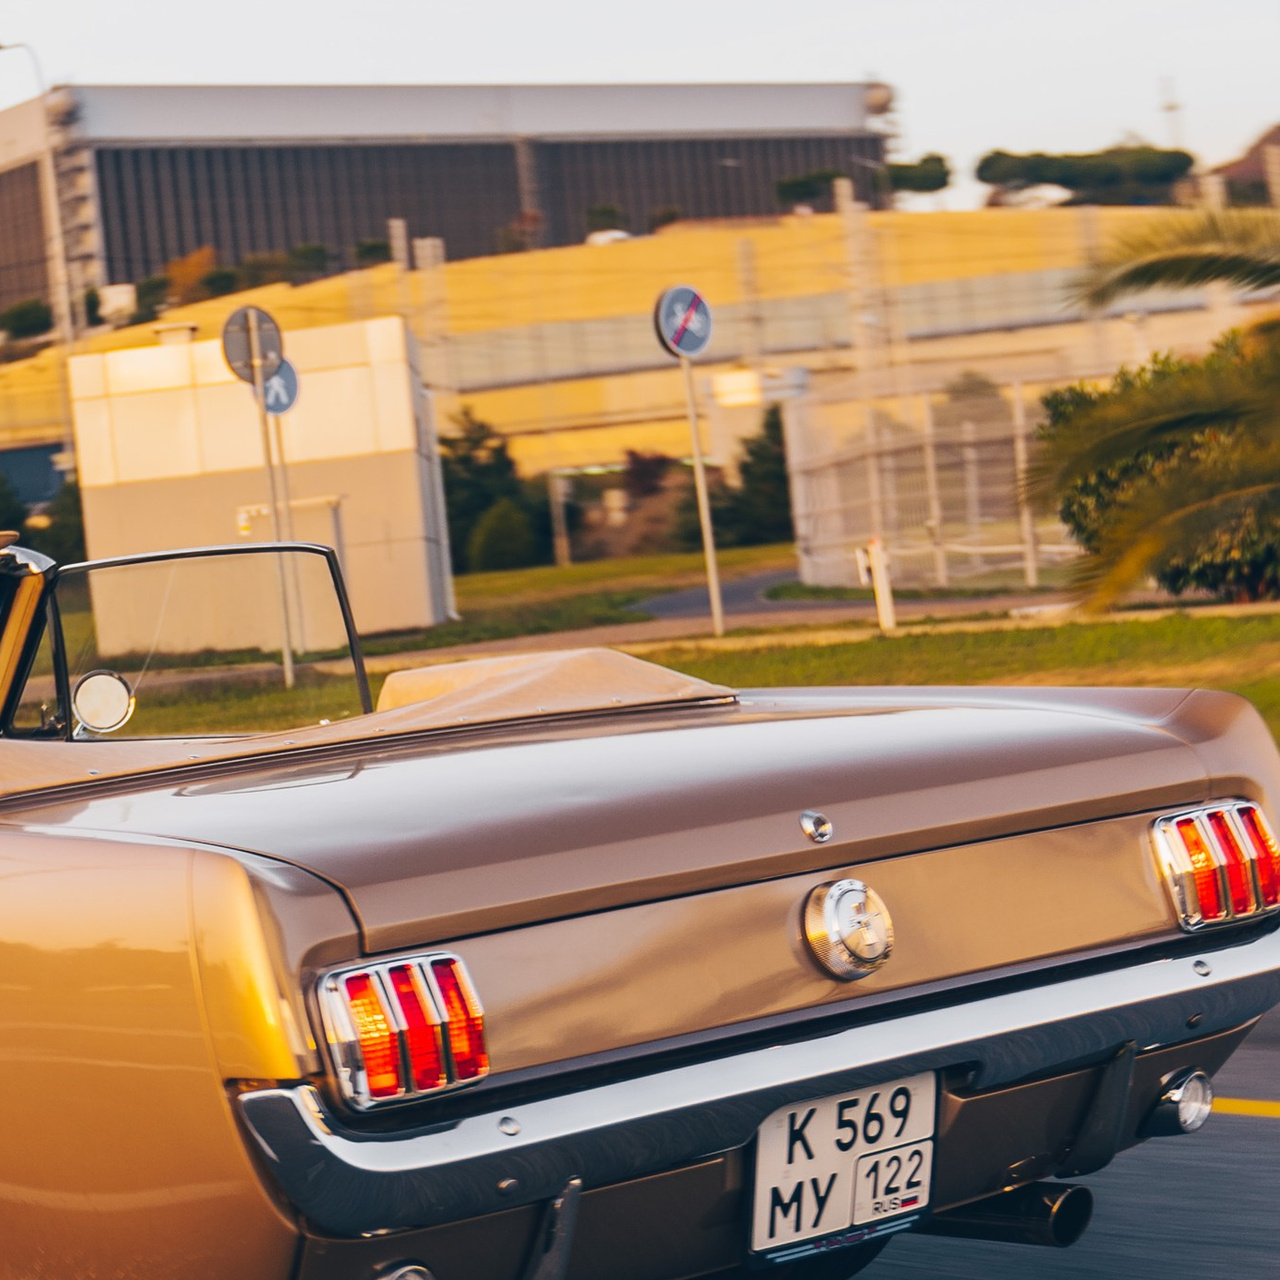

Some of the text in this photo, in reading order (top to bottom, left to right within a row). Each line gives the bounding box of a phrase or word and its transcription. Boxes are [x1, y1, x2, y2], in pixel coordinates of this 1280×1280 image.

[787, 1086, 911, 1165] K 569
[866, 1149, 924, 1200] 122
[768, 1172, 838, 1239] MY
[872, 1196, 900, 1215] RUS
